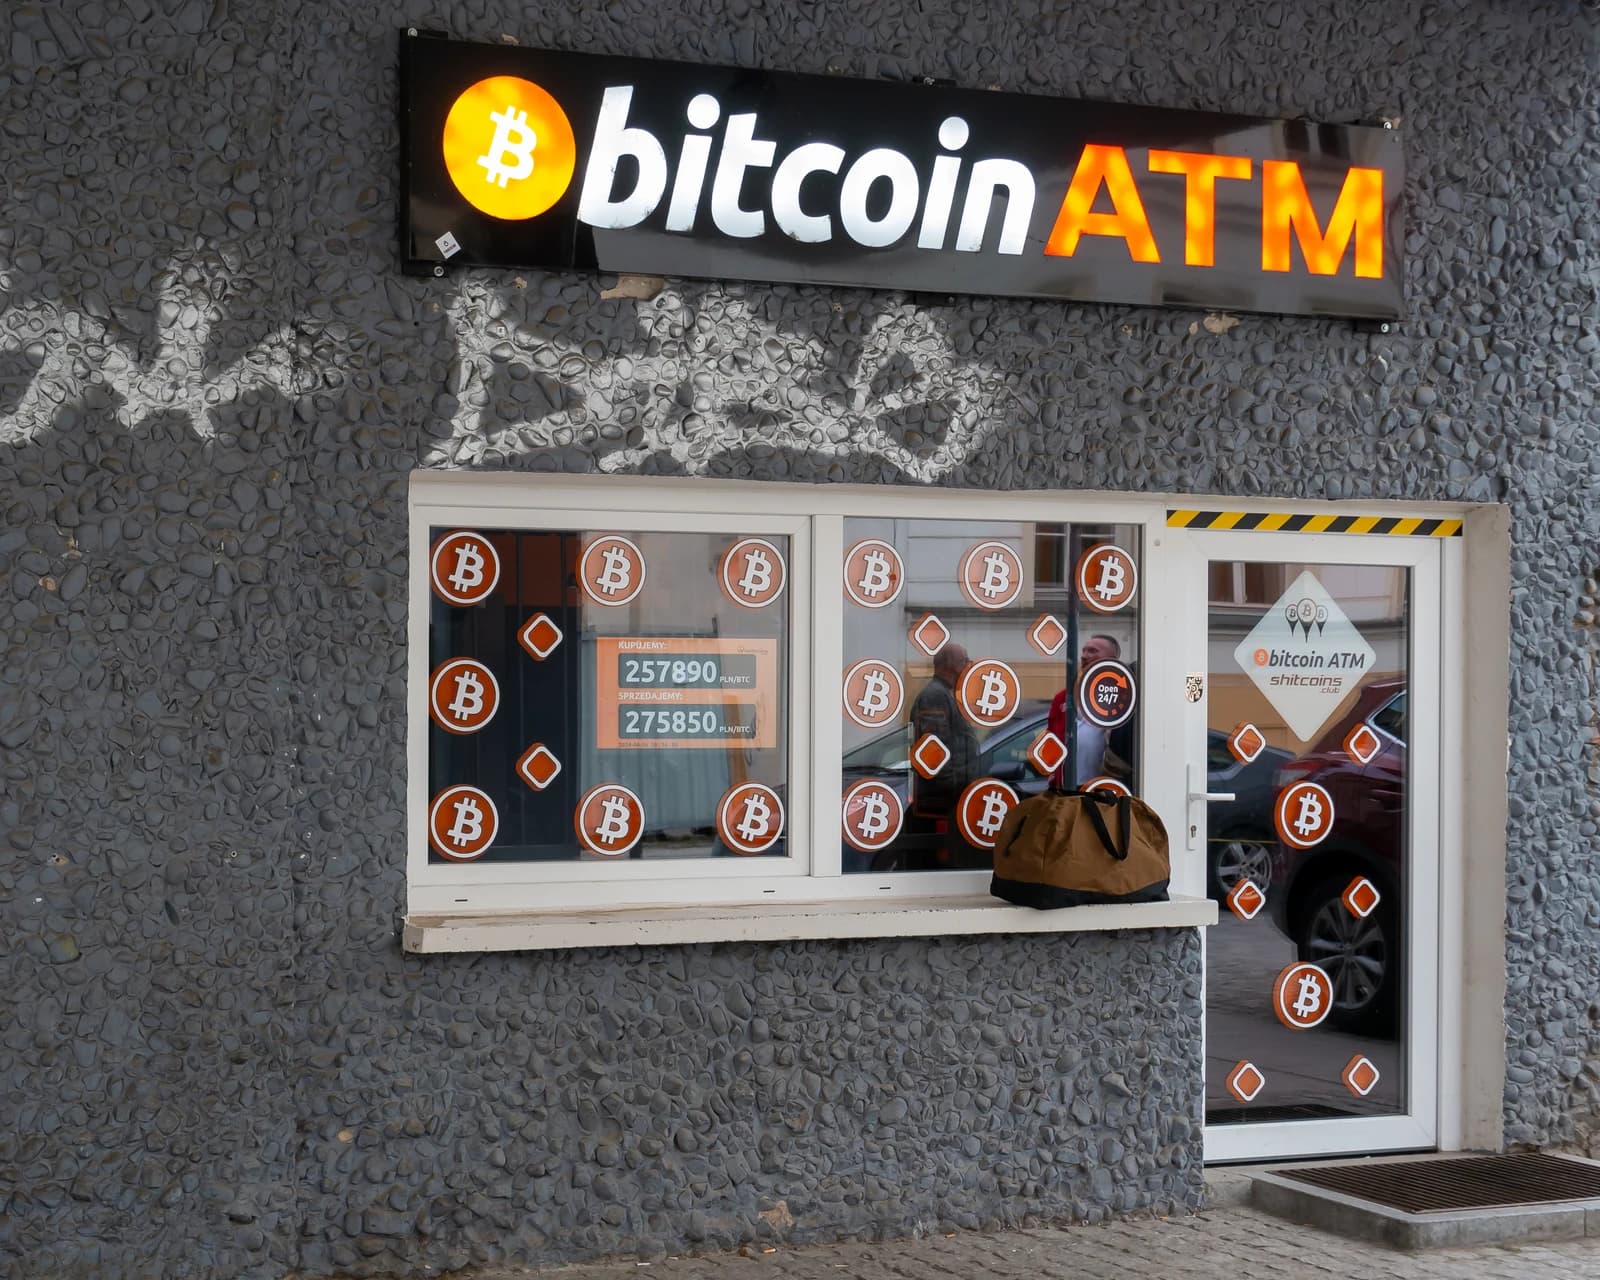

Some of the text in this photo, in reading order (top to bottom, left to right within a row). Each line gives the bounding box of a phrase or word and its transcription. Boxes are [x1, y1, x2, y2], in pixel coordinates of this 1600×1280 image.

[577, 85, 1384, 279] bitcoin ATM
[1269, 650, 1365, 669] bitcoin ATM
[625, 660, 750, 684] 257890 PLN/BTC
[1270, 674, 1342, 687] shitcoins
[618, 692, 683, 701] SPRZEDAJEMY:
[1098, 684, 1118, 694] Open
[1098, 693, 1118, 704] 24/7
[625, 711, 750, 734] 275850 PLN/BTC
